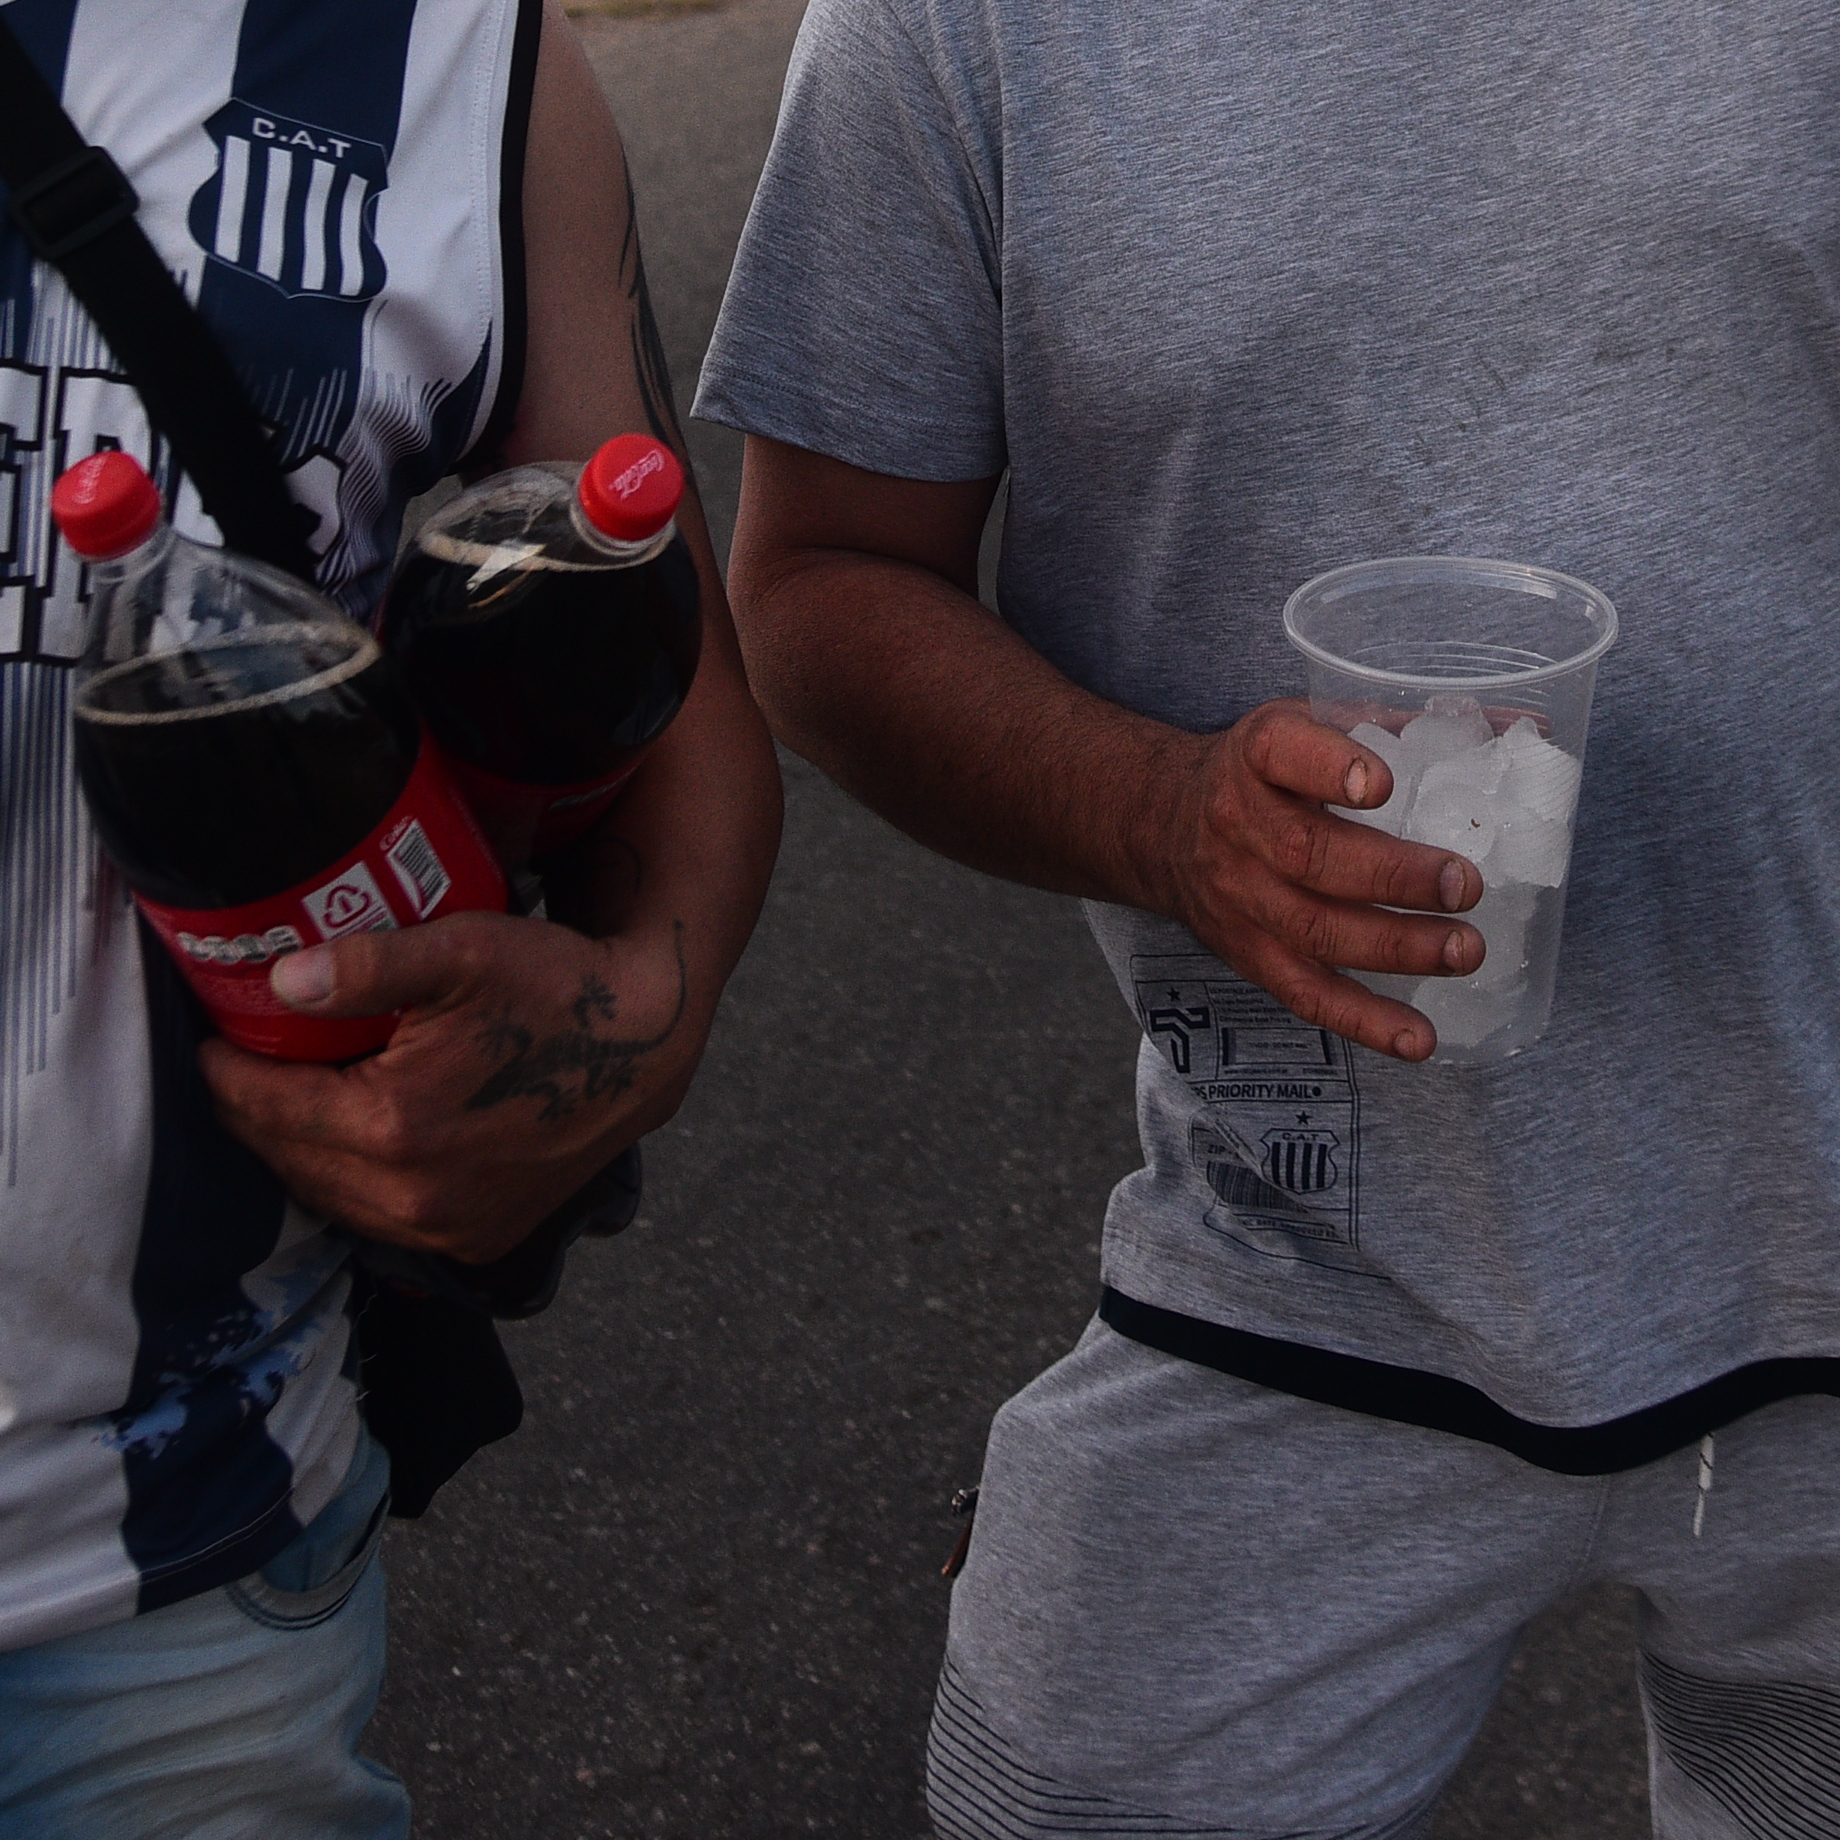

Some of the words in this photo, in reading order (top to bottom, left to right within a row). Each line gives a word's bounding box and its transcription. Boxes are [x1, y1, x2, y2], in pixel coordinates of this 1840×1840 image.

[249, 113, 354, 162] C.A.T
[1208, 1083, 1275, 1099] PRIORITY
[1276, 1083, 1312, 1099] MAIL
